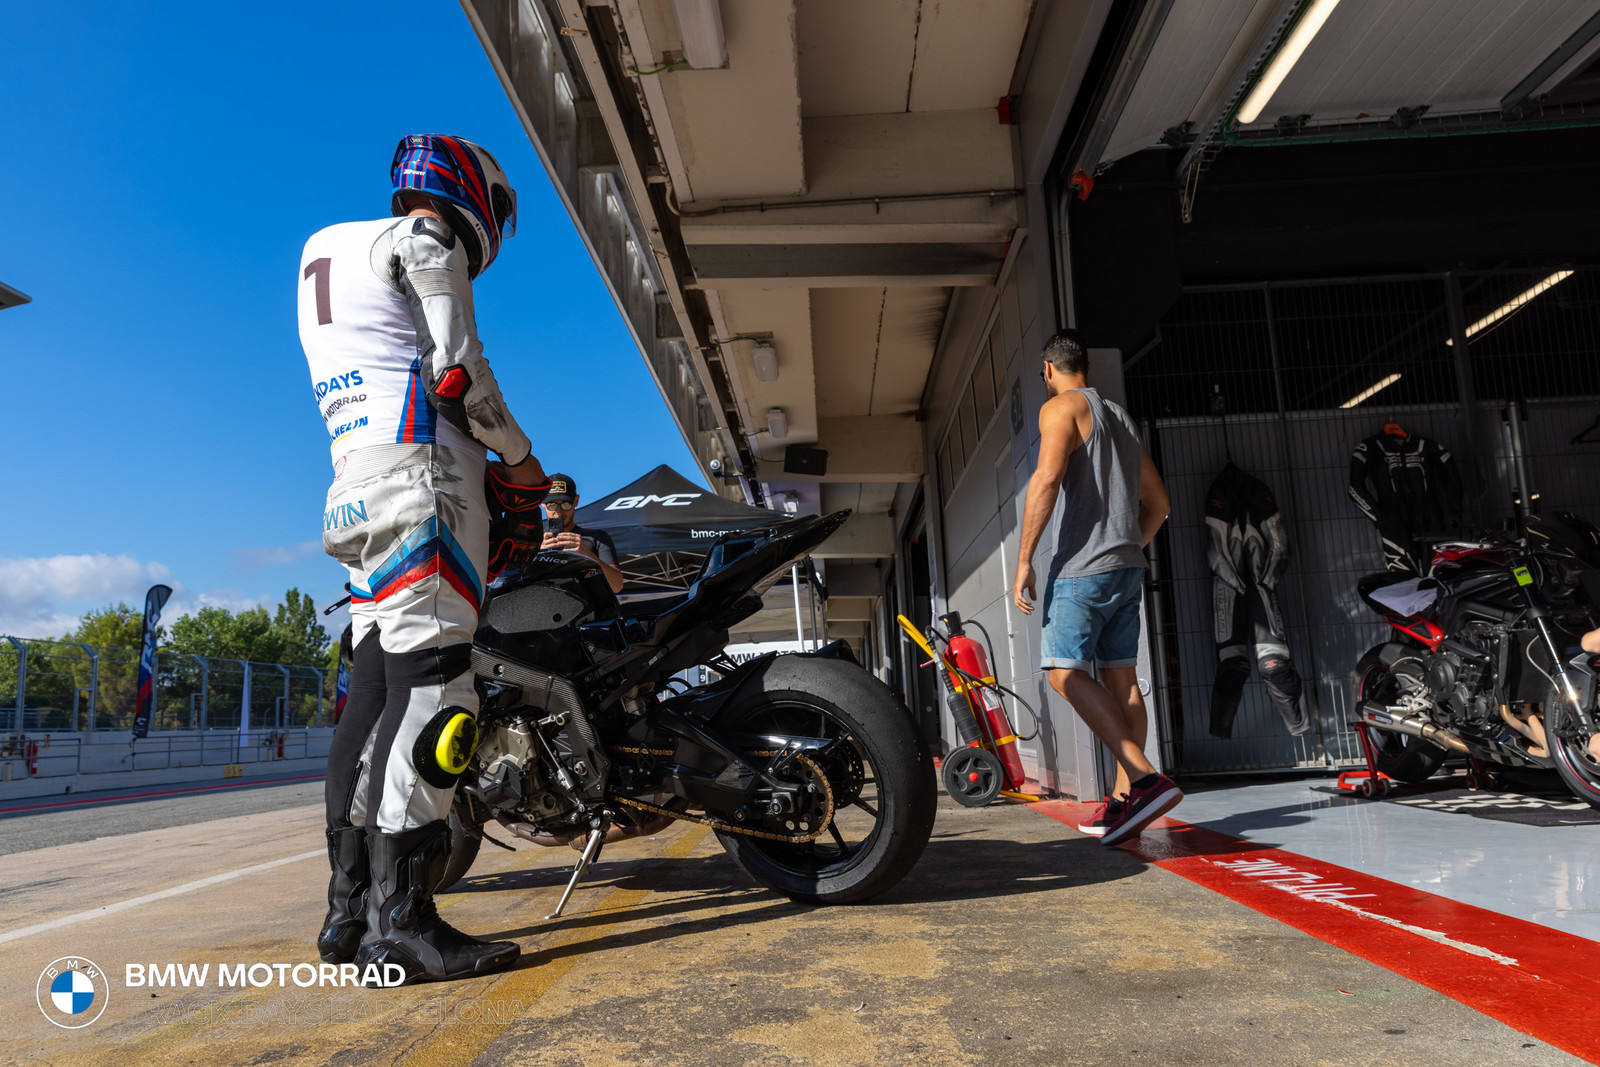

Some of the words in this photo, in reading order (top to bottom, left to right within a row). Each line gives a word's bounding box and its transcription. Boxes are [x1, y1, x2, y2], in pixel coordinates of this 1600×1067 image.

[304, 258, 333, 326] 1
[313, 369, 364, 405] KDAYS
[325, 394, 367, 418] MOTORRAD
[604, 493, 702, 511] BMC
